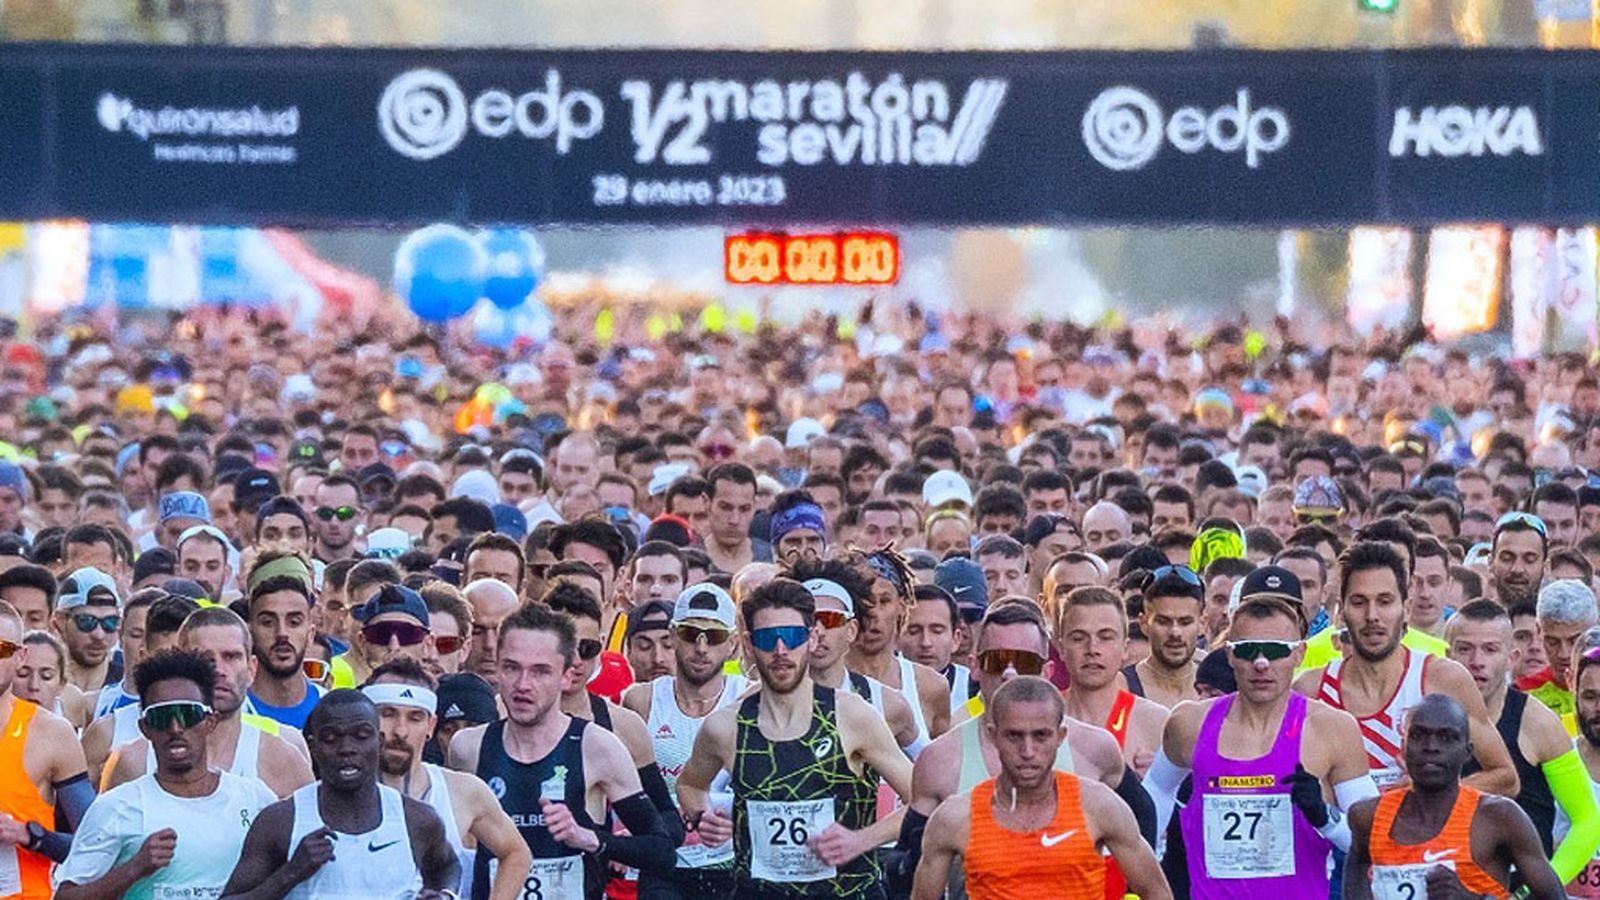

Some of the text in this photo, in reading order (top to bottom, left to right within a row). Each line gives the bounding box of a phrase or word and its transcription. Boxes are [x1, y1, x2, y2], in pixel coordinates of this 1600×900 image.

[471, 69, 604, 154] edp
[690, 72, 951, 123] maratón
[757, 122, 957, 165] sevilla
[1166, 88, 1290, 168] edp
[1389, 105, 1544, 157] HOKA
[592, 174, 787, 205] 29 enero 2023
[768, 817, 809, 847] 26
[1223, 812, 1263, 841] 27
